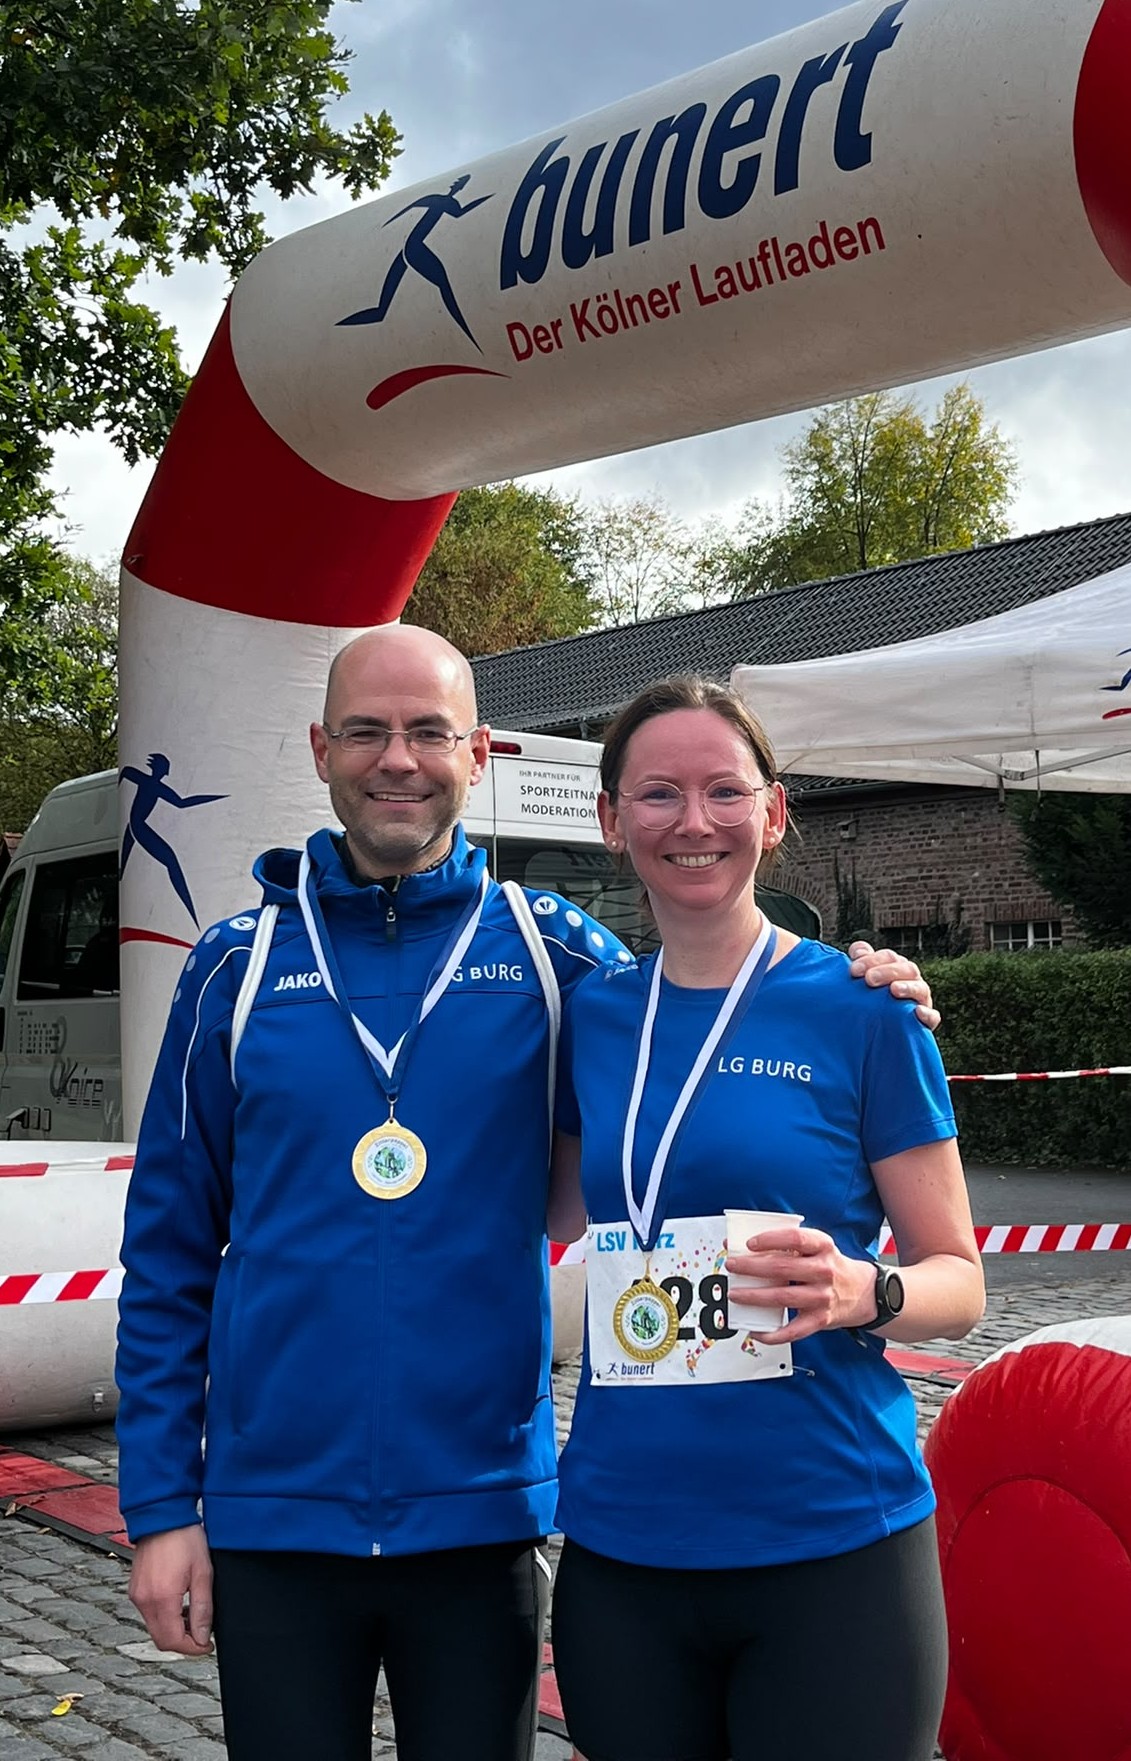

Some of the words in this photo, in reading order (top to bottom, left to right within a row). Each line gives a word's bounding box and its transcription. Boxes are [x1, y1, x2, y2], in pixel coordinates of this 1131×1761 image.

[500, 0, 909, 291] bunert
[506, 318, 563, 362] Der
[569, 279, 681, 342] Kölner
[690, 216, 886, 306] Laufladen
[533, 771, 565, 780] PARTNER
[520, 785, 599, 800] SPORTZEITNA
[521, 803, 596, 818] MODERATION
[274, 971, 322, 991] JAKO
[452, 966, 463, 982] G
[470, 963, 522, 981] BURG
[718, 1056, 745, 1073] LG
[751, 1058, 812, 1082] BURG
[597, 1231, 626, 1252] LSV
[633, 1233, 675, 1250] rz
[631, 1274, 739, 1340] 28
[621, 1361, 655, 1375] bunert
